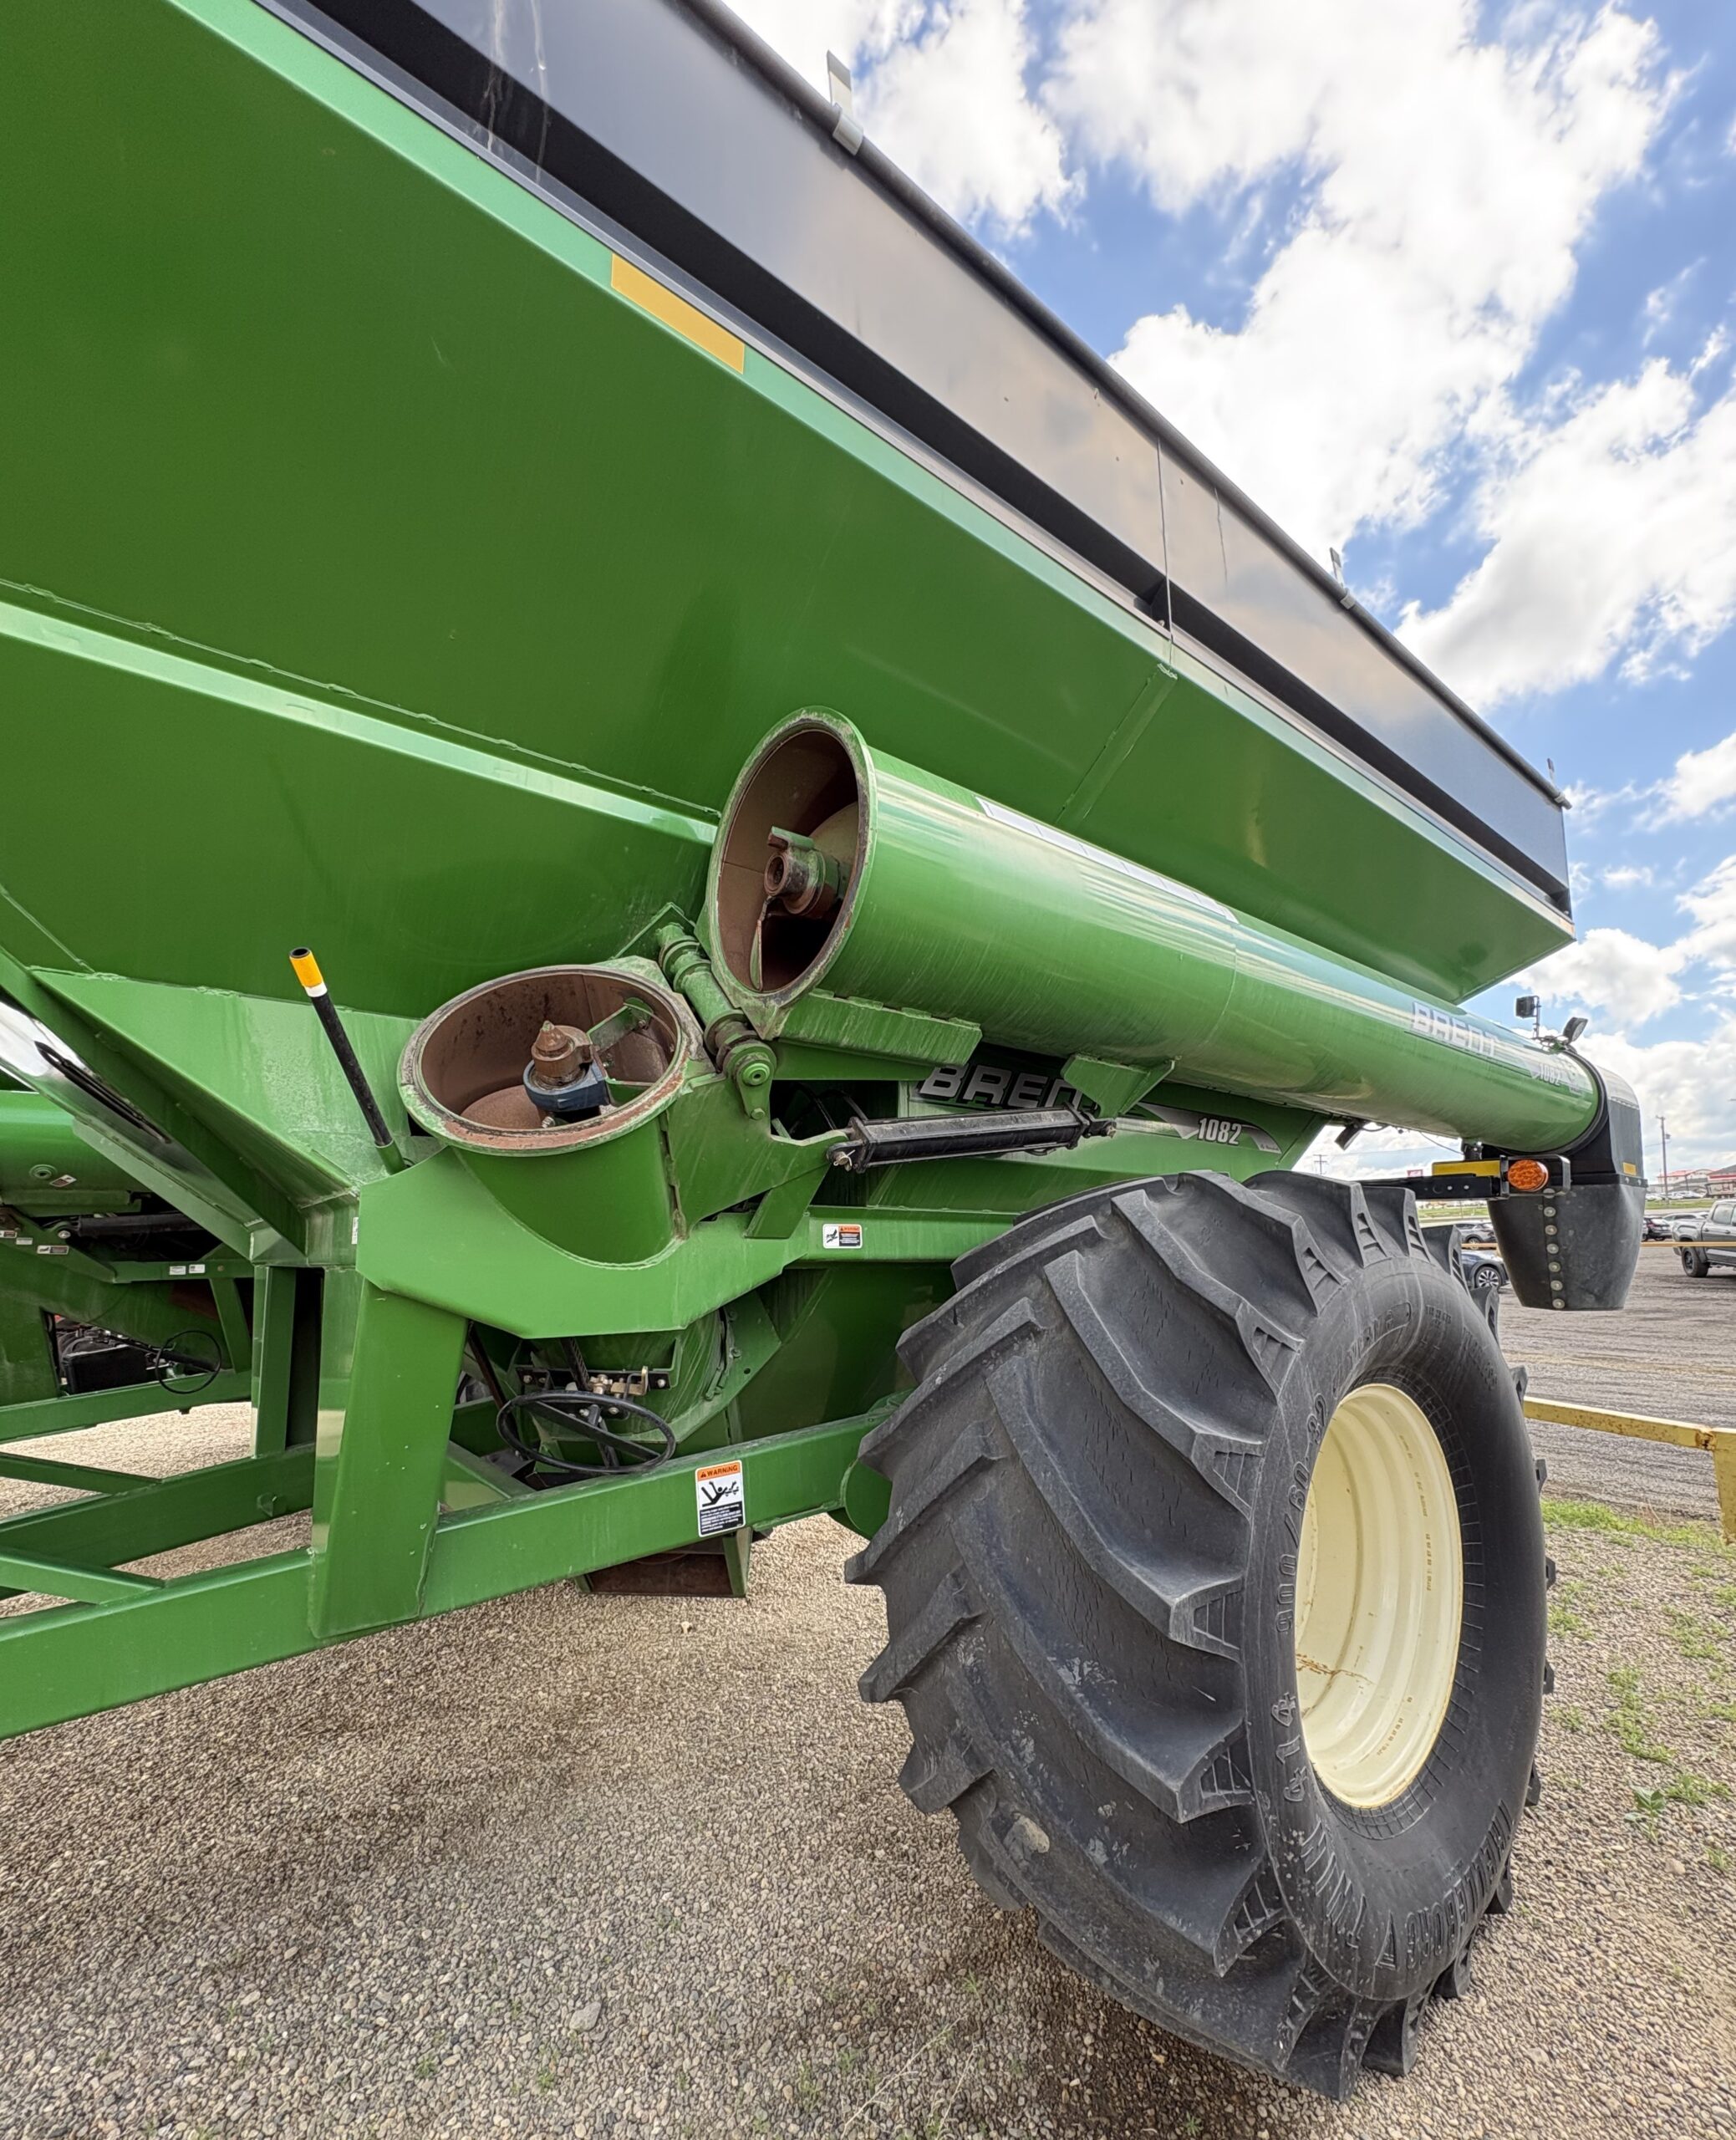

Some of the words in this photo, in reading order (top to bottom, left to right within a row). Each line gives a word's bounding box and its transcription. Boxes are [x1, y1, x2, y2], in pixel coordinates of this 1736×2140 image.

[1412, 1001, 1499, 1058] BRENT
[919, 1064, 1085, 1110] BREN
[1198, 1117, 1243, 1145] 1082
[707, 1465, 739, 1477] WARNING
